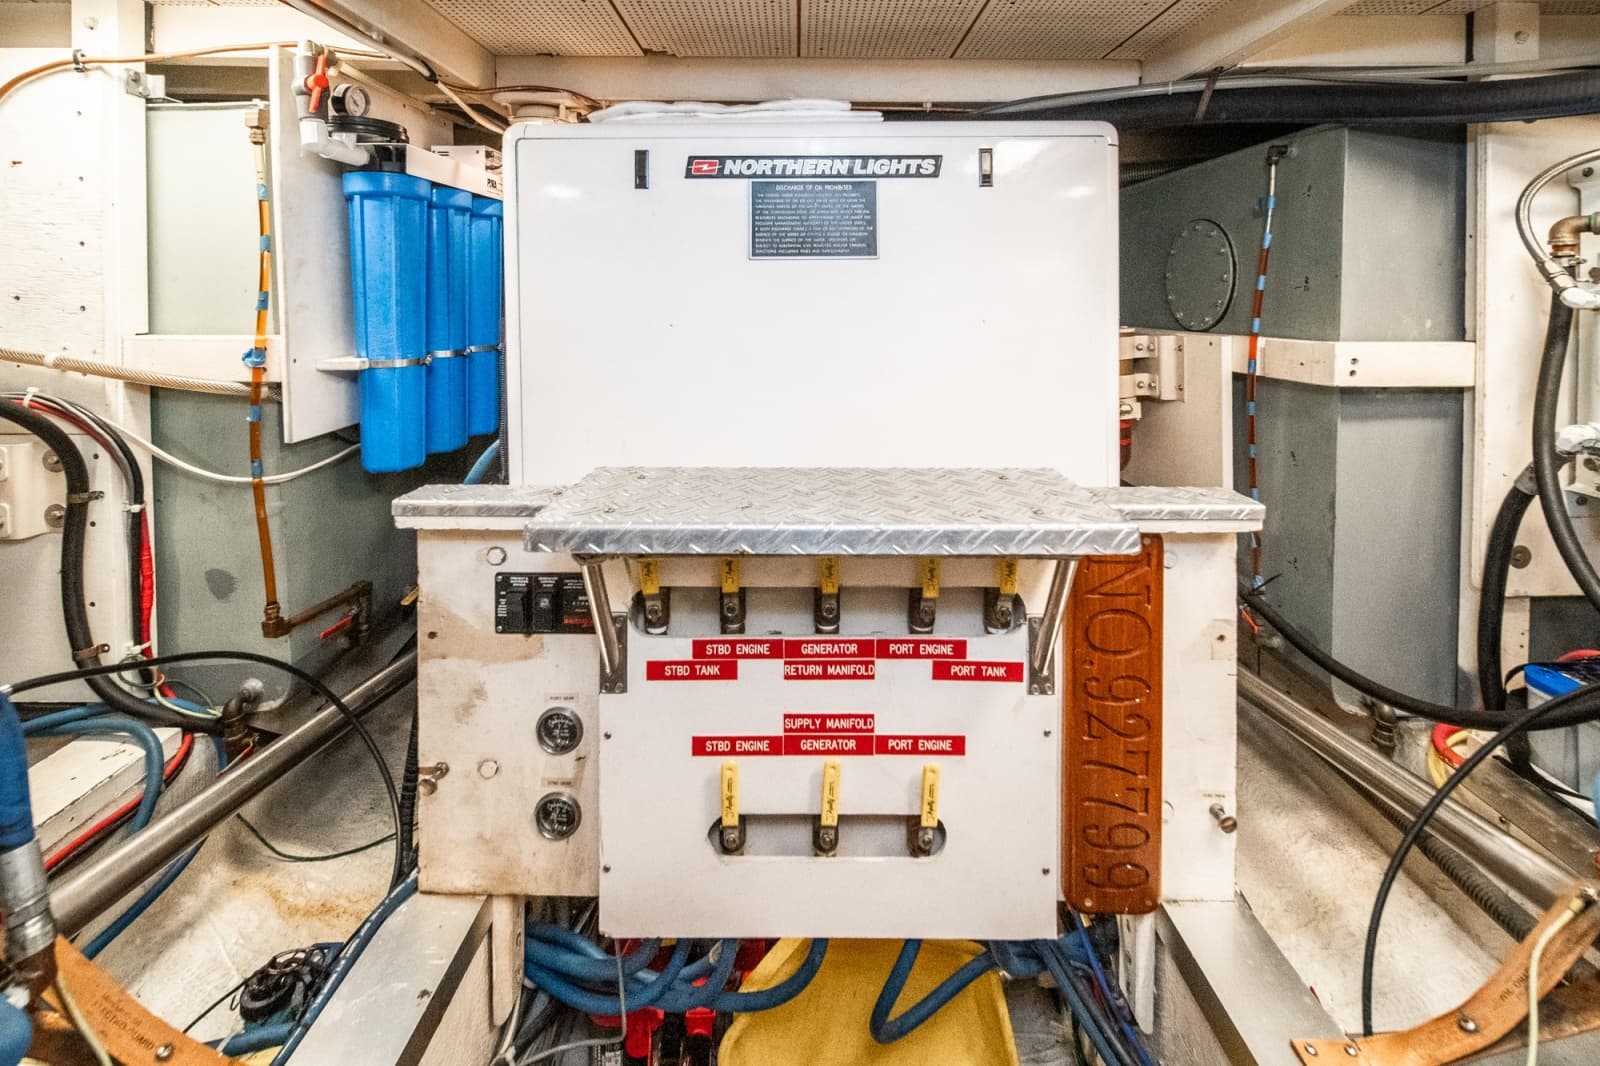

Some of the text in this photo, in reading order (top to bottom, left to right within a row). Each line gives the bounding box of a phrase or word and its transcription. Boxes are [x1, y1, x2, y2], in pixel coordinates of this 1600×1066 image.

[724, 159, 936, 176] NORTHERN LIGHTS
[706, 643, 770, 656] STBD ENGINE
[801, 643, 858, 655] GENERATOR
[889, 643, 954, 656] PORT ENGINE
[664, 664, 720, 676] STBD TANK
[785, 664, 875, 676] RETURN MANIFOLD
[951, 665, 1006, 678] PORT TANK
[784, 717, 873, 730] SUPPLY MANIFOLD
[706, 739, 770, 752] STBD ENGINE
[800, 738, 856, 751] GENERATOR
[888, 738, 952, 751] PORT ENGINE
